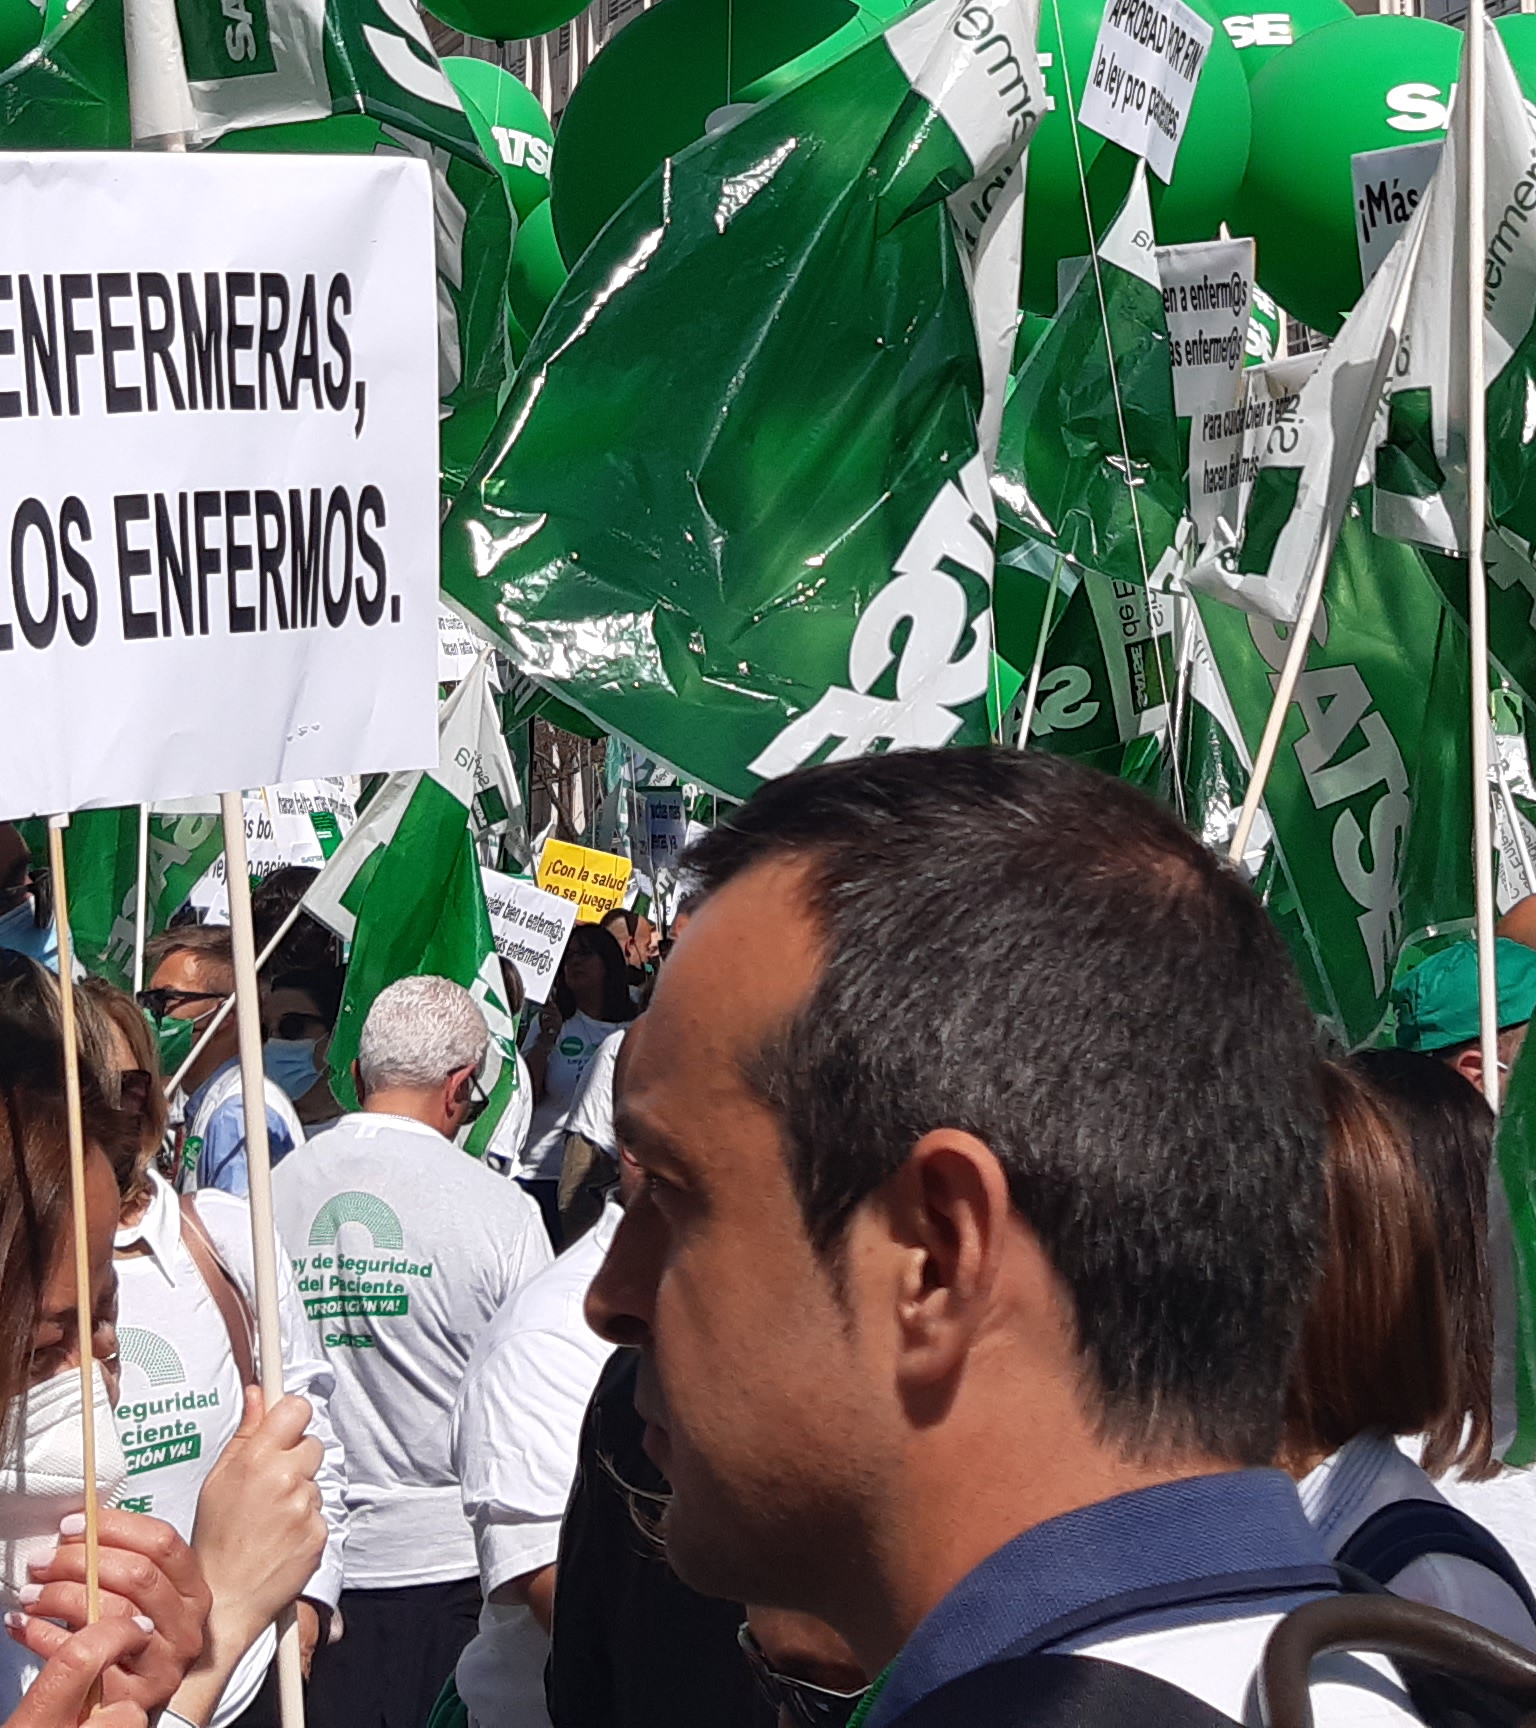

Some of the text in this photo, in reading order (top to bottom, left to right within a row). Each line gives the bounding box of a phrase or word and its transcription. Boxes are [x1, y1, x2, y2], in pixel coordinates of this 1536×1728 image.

[1092, 43, 1107, 90] la
[1104, 51, 1126, 109] ley
[1121, 74, 1146, 114] pro
[1190, 271, 1248, 317] enferm@s
[113, 484, 403, 641] ENFERMOS.
[545, 858, 626, 892] ¡Con la salud
[544, 883, 560, 897] no
[563, 887, 577, 901] se
[311, 1253, 334, 1270] de
[337, 1253, 434, 1279] Seguridad
[298, 1274, 405, 1294] del Paciente
[379, 1299, 401, 1313] YA!
[116, 1387, 220, 1423] eguridad
[168, 1440, 194, 1460] YA!
